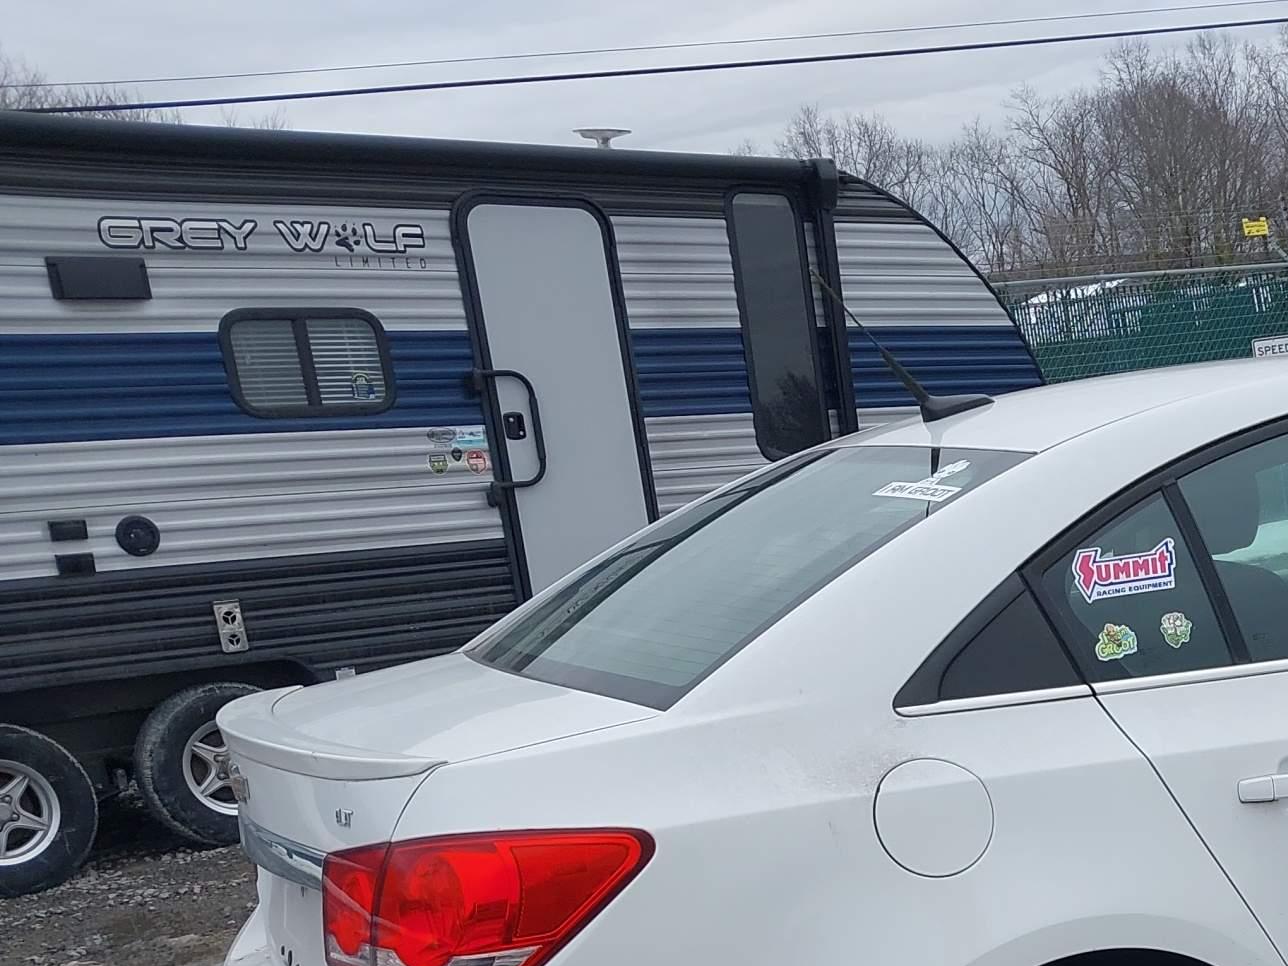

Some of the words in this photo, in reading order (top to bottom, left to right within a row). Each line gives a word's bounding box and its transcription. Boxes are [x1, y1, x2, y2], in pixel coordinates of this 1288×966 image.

[98, 217, 257, 251] GREY
[334, 255, 427, 270] LIMITED
[908, 486, 956, 499] GROOT
[1096, 586, 1127, 598] RACING
[1128, 580, 1174, 593] EQUIPMENT
[1098, 637, 1137, 657] GROOT
